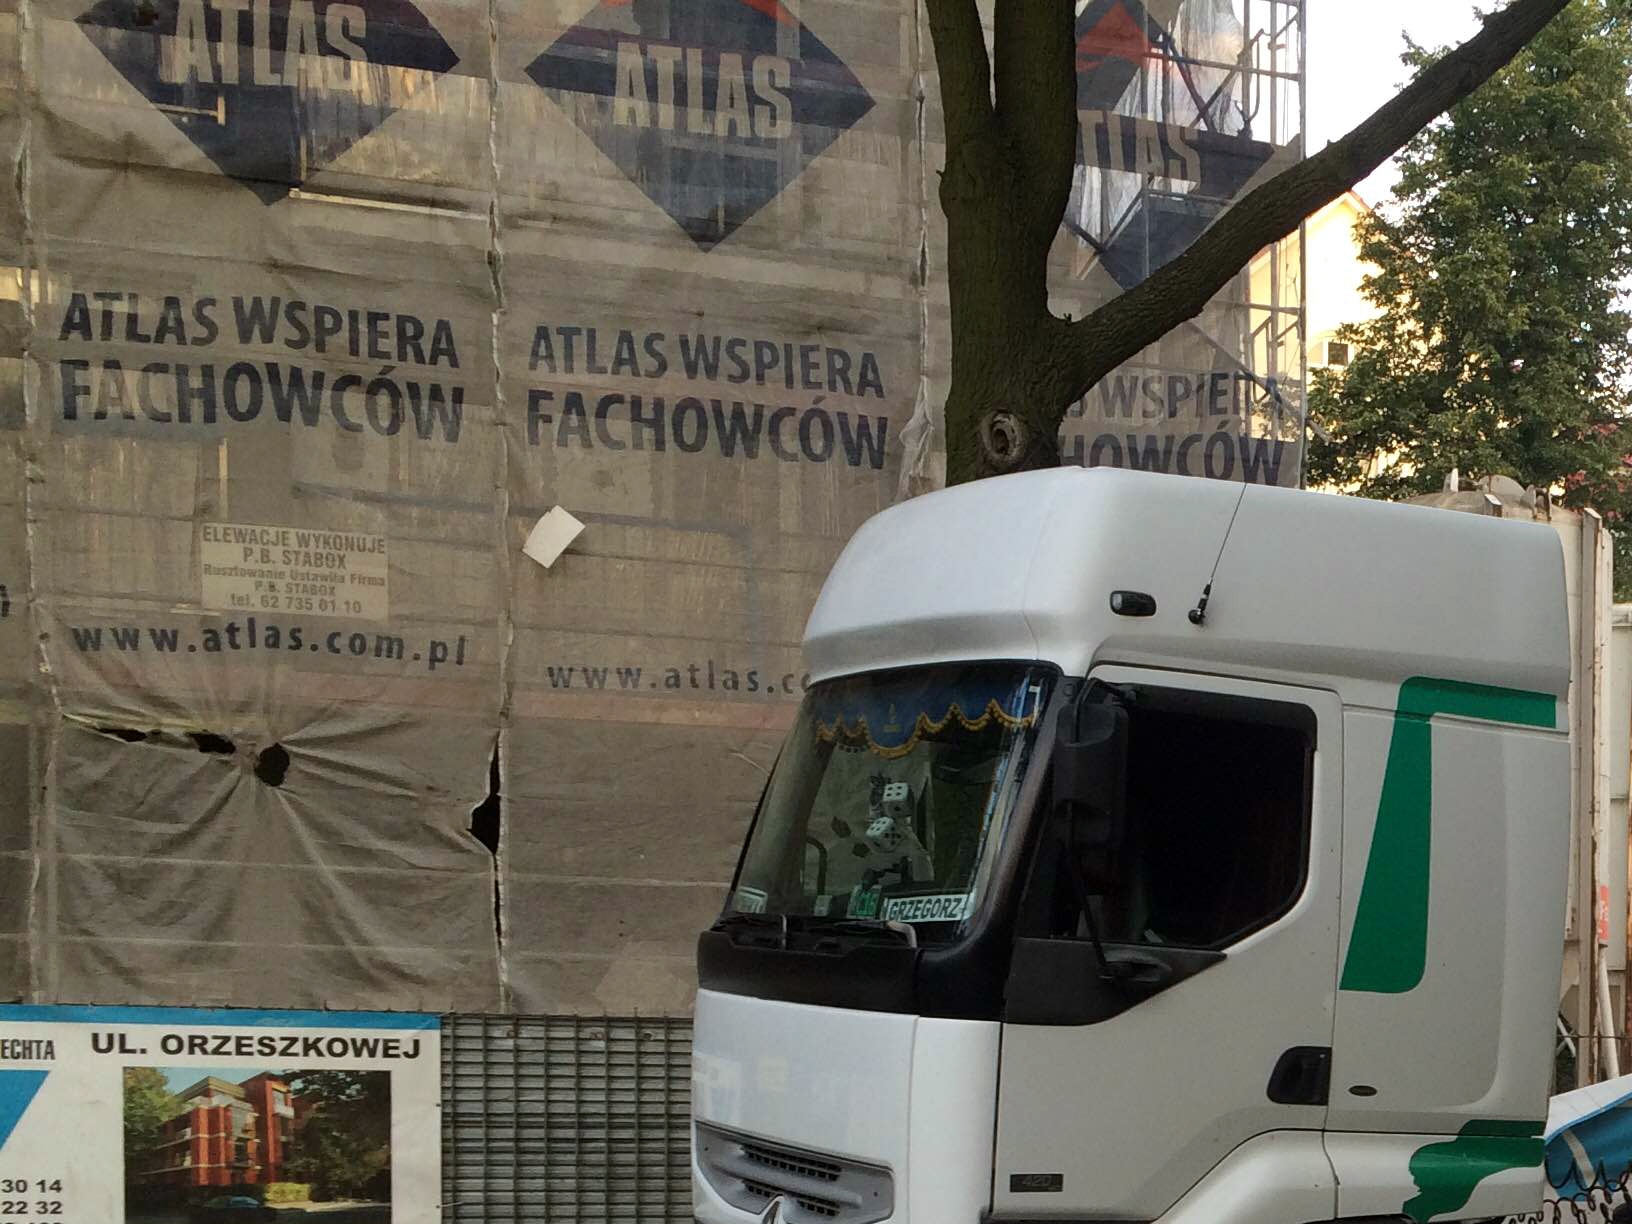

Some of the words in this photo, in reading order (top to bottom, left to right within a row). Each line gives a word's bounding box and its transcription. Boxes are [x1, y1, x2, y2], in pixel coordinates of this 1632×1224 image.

[158, 0, 373, 104] ATLAS
[612, 41, 794, 139] ATLAS
[1077, 109, 1202, 184] TLAS
[58, 291, 219, 346] ATLAS
[231, 295, 461, 369] WSPIERA
[528, 325, 668, 379] ATLAS
[678, 333, 886, 399] WSPIERA
[60, 358, 465, 443] FACHOWCÓW
[527, 388, 888, 470] FACHOWCÓW
[202, 525, 290, 547] ELEWACJE
[295, 533, 386, 555] WYKONUJE
[243, 547, 276, 565] P.B.
[282, 550, 347, 570] STABOX
[285, 582, 336, 597] STABOX
[350, 573, 386, 587] Firma
[260, 595, 280, 609] 62
[285, 597, 314, 612] 735
[72, 617, 467, 671] www.atlas.com.pl
[889, 898, 963, 920] GRZEGORZ
[91, 1032, 147, 1055] UL.
[160, 1034, 421, 1059] ORZESZKOWEJ
[1, 1179, 28, 1193] 30
[35, 1179, 63, 1193] 14
[1, 1200, 28, 1215] 22
[34, 1200, 63, 1215] 32
